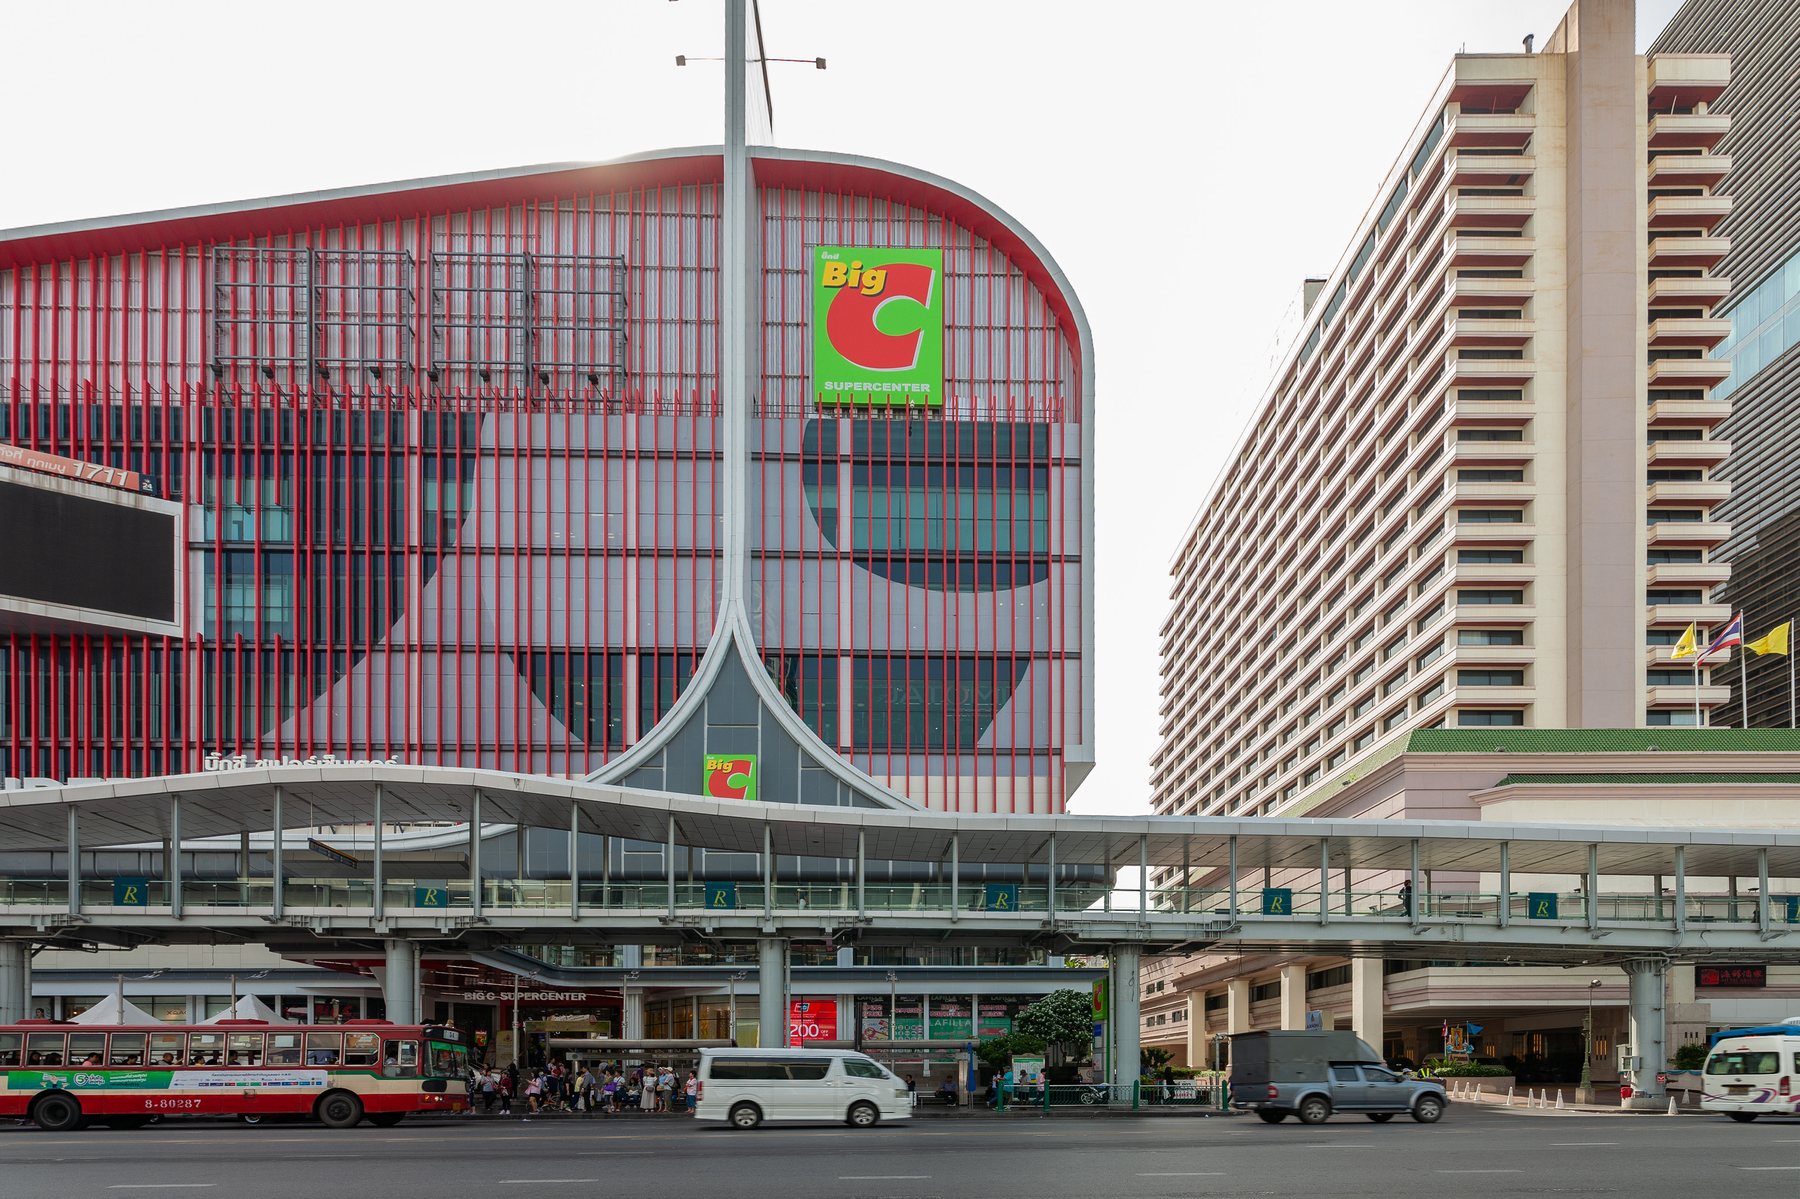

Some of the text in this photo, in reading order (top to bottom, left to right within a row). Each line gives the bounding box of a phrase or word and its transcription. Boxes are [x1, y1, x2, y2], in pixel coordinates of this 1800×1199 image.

[822, 260, 935, 372] Big C
[824, 381, 931, 392] SUPERCENTER
[73, 461, 128, 487] 1711
[707, 759, 733, 774] Big
[124, 886, 138, 901] R
[425, 888, 437, 903] R
[714, 890, 727, 905] R
[996, 892, 1008, 907] R
[1271, 896, 1283, 910] R
[1537, 901, 1549, 914] R
[464, 992, 484, 1001] BIG
[500, 992, 587, 1001] SUPERCENTER
[790, 1024, 819, 1038] 200
[145, 1099, 202, 1109] 8-80287
